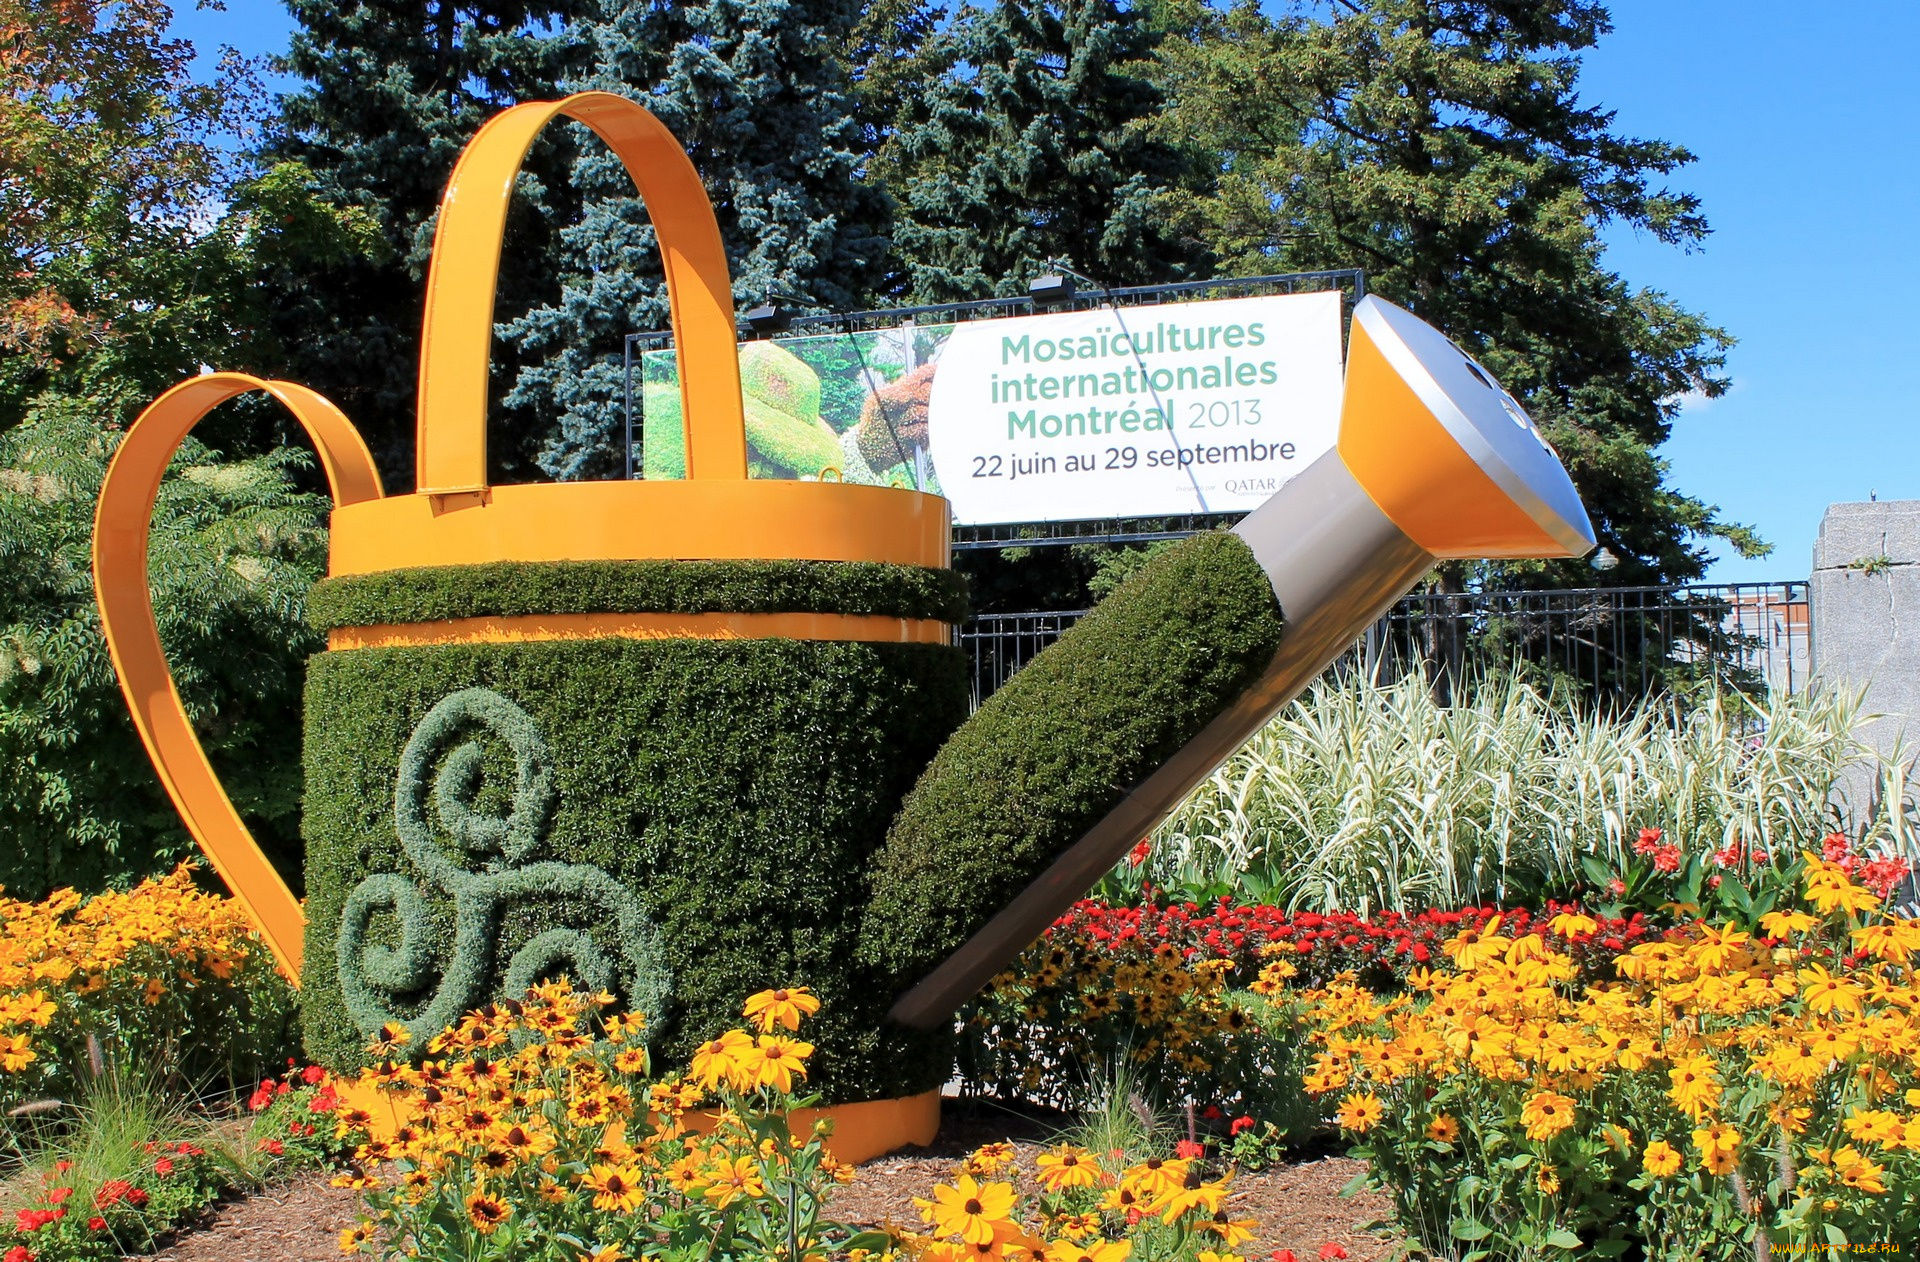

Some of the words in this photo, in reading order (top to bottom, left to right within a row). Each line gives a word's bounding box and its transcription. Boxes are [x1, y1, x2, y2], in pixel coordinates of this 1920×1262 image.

[1001, 321, 1265, 365] Mosaïcultures
[991, 356, 1278, 403] internationales
[1007, 399, 1173, 440] Montréal
[1188, 398, 1263, 428] 2013
[971, 455, 1003, 478] 22
[1009, 452, 1057, 480] juin
[1064, 454, 1096, 473] au
[1104, 446, 1138, 470] 29
[1146, 438, 1296, 470] septembre
[1225, 478, 1276, 493] QATAR
